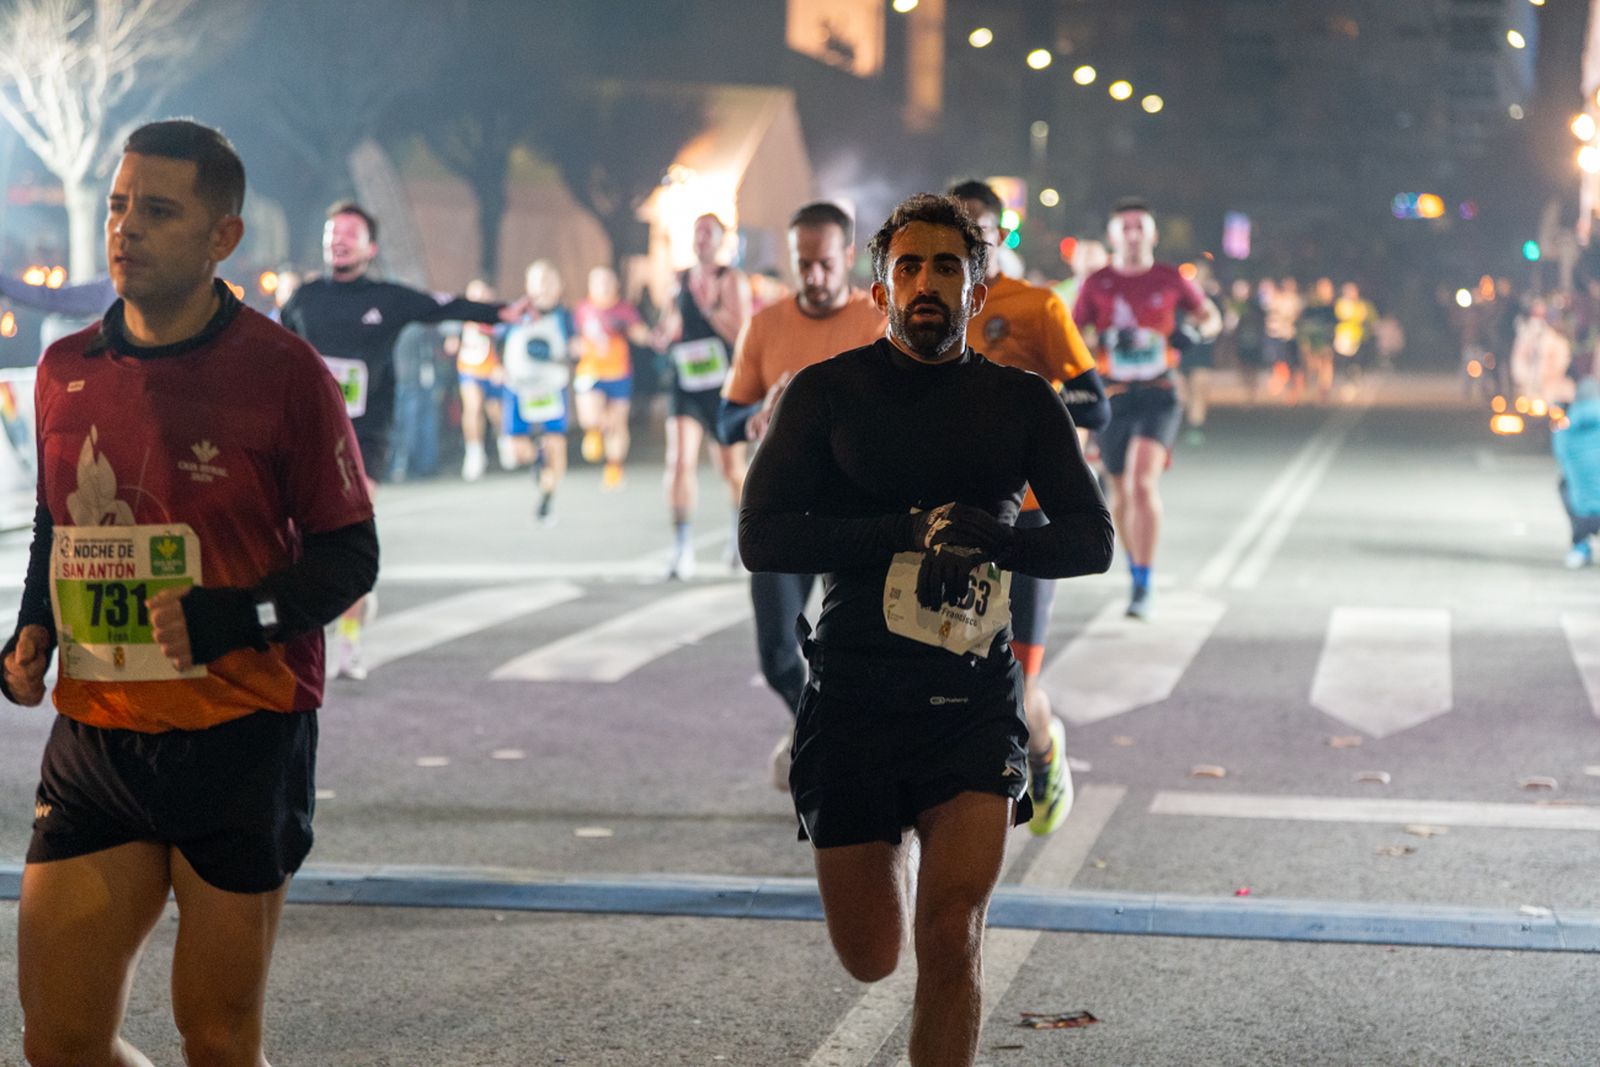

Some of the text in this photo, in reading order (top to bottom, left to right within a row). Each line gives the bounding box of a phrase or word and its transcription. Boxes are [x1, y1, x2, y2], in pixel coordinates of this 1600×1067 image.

[73, 544, 134, 559] NOCHE DE
[62, 563, 85, 578] SAN
[87, 559, 136, 579] ANTÓN
[86, 582, 149, 628] 731
[956, 575, 992, 617] 63
